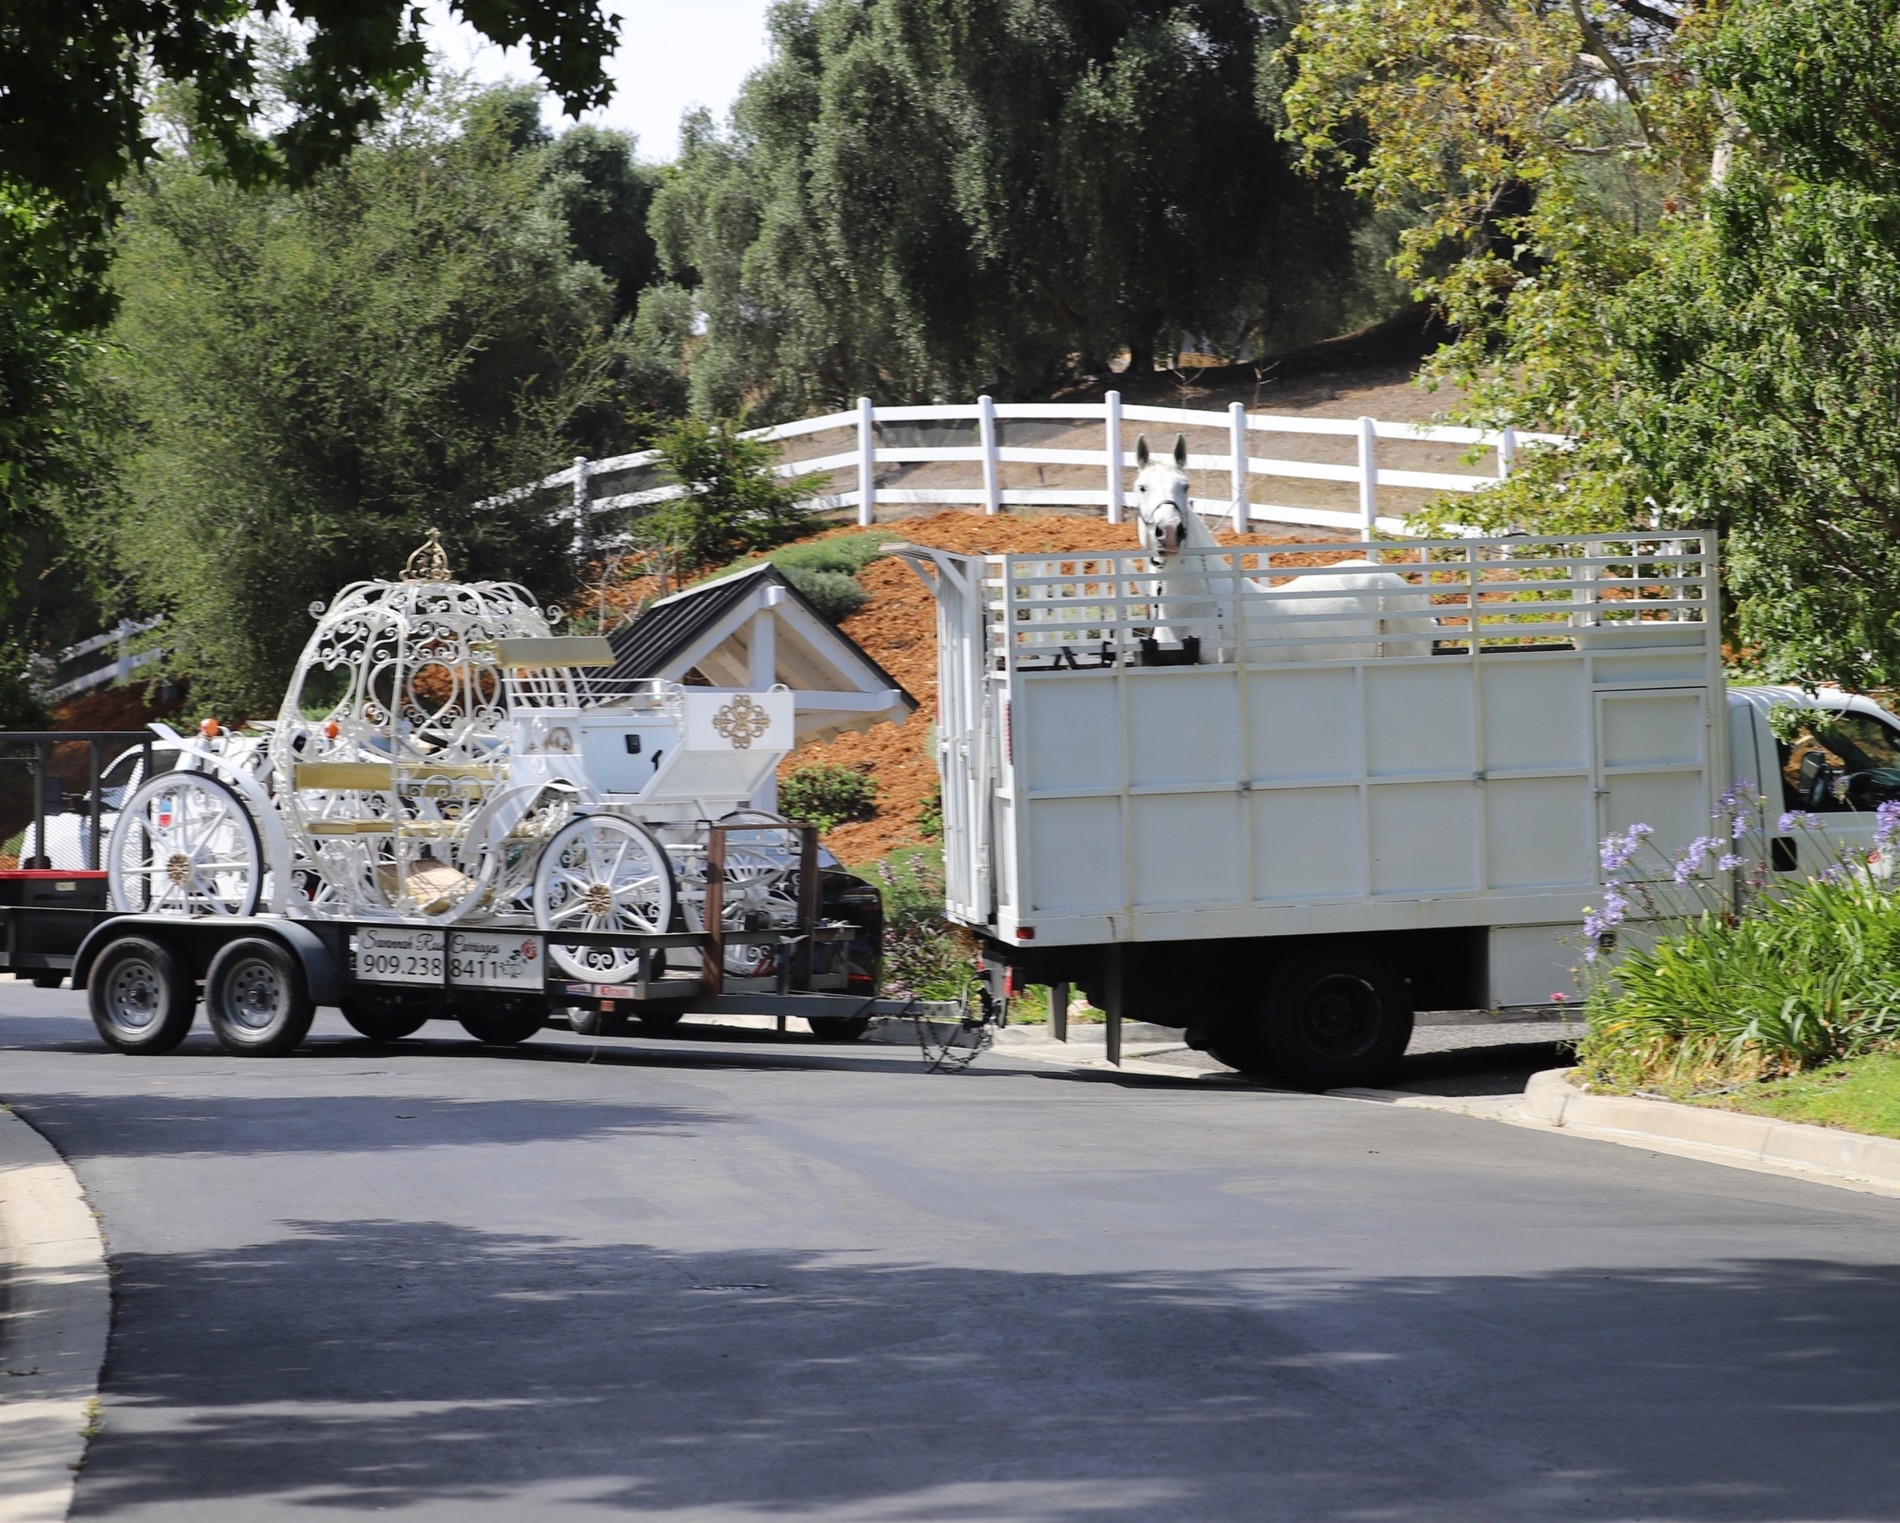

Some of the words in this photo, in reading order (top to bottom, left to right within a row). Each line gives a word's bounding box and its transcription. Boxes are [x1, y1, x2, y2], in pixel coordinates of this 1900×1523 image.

[361, 929, 414, 949] Savannah
[451, 935, 500, 959] Carriages
[363, 954, 442, 976] 909.238
[450, 959, 498, 979] 8411
